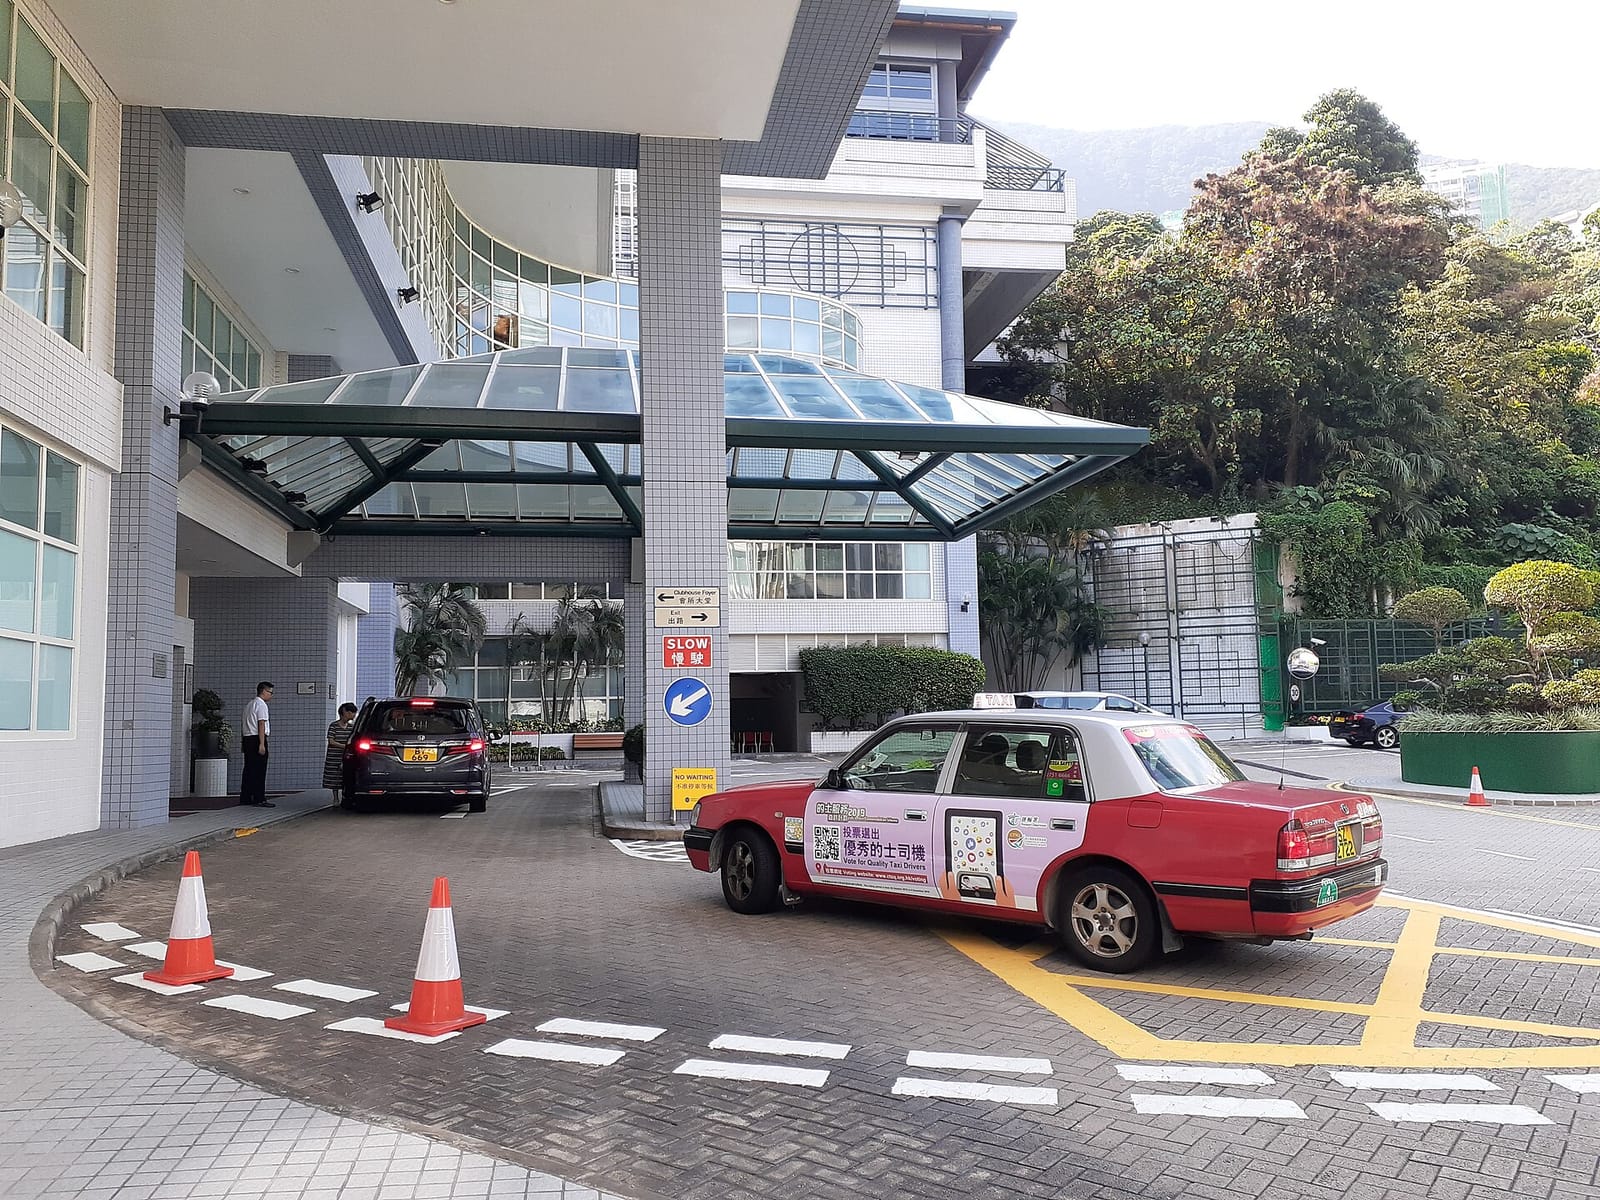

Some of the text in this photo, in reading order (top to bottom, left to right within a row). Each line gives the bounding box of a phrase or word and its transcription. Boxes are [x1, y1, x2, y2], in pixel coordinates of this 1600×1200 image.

[667, 638, 708, 649] SLOW
[671, 651, 704, 665] 慢駛
[985, 694, 1013, 706] TAXI
[843, 826, 880, 839] 投票選出
[844, 840, 926, 861] 優秀的士司機
[843, 857, 857, 865] Vote
[867, 860, 888, 869] Quality
[904, 862, 926, 870] Drivers
